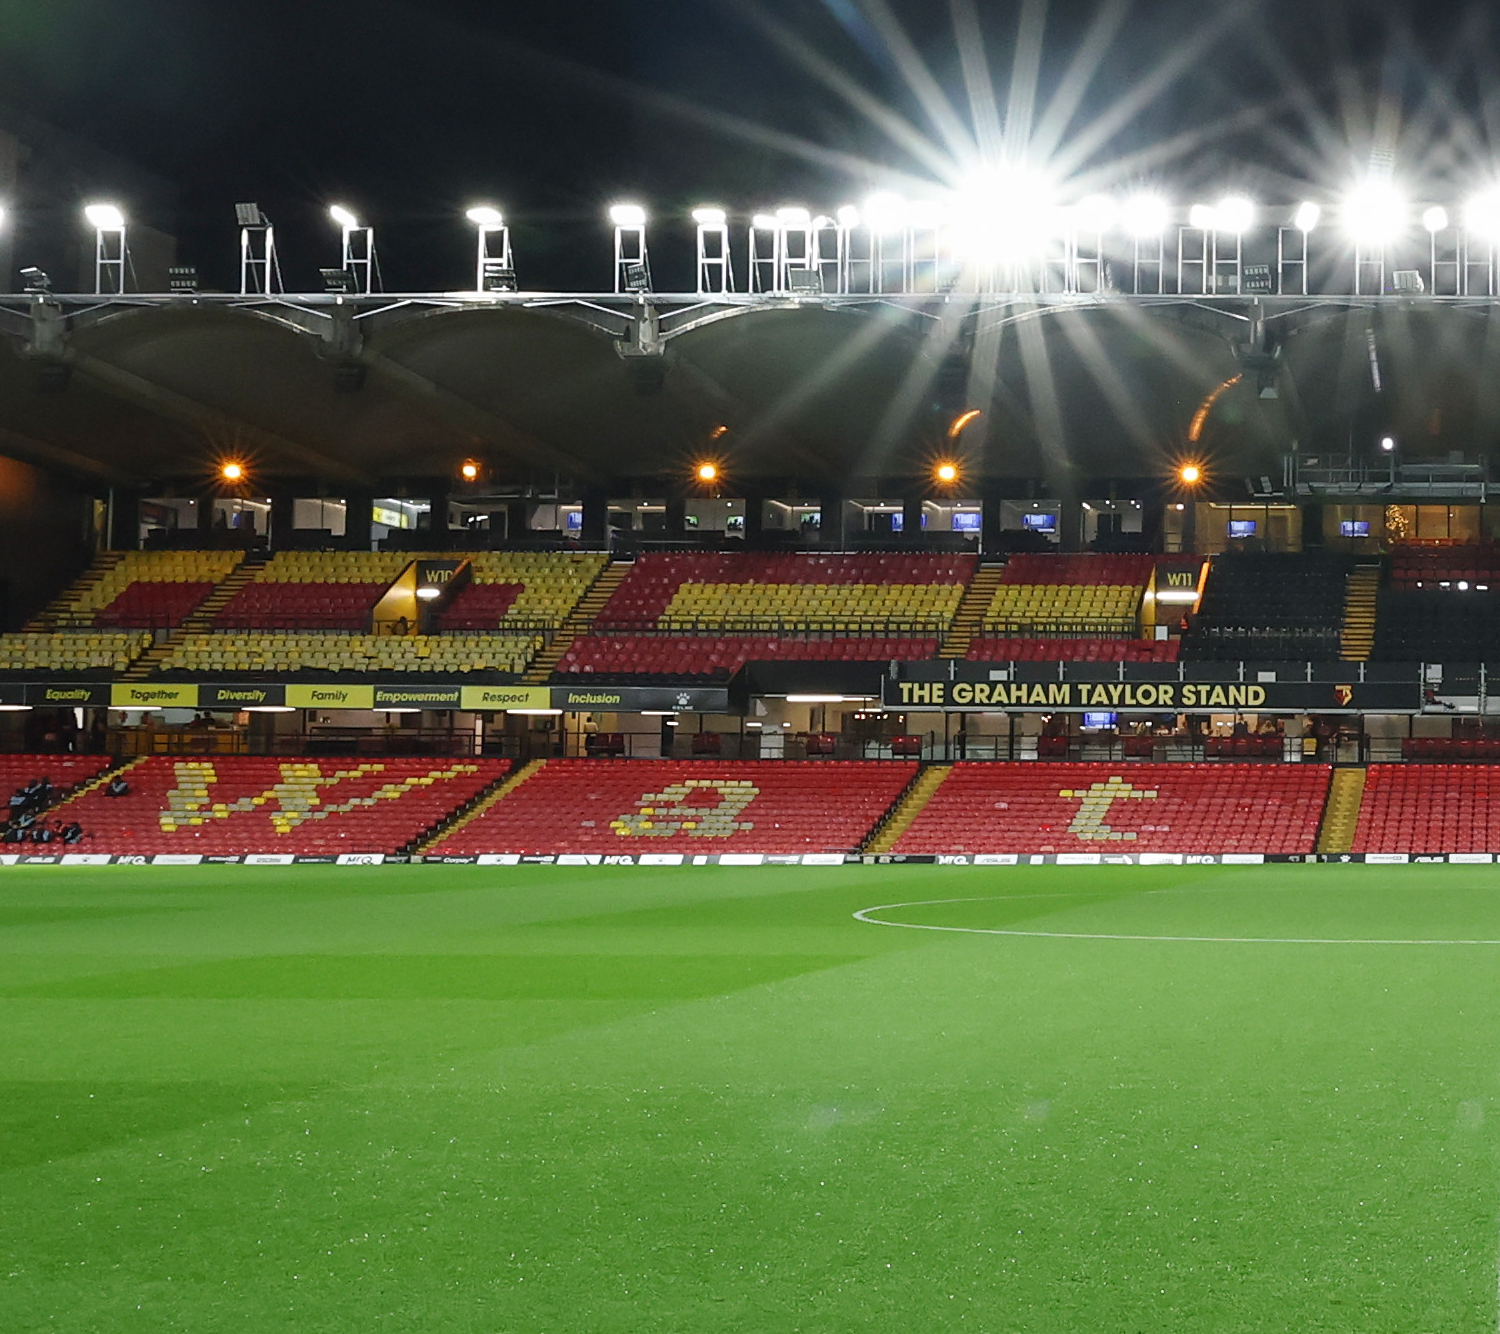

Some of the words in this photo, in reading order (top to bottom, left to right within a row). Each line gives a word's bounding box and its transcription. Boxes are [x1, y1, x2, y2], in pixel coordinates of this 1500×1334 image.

[1167, 573, 1192, 586] W11
[45, 689, 91, 701] Equality
[130, 689, 179, 701] Together
[217, 689, 266, 702] Diversity
[311, 690, 348, 702] Family
[376, 691, 458, 703] Empowerment
[481, 692, 529, 703] Respect
[568, 693, 620, 704] Inclusion
[899, 682, 944, 704] THE
[952, 682, 1071, 704] GRAHAM
[1078, 684, 1174, 705] TAYLOR
[1181, 684, 1266, 706] STAND
